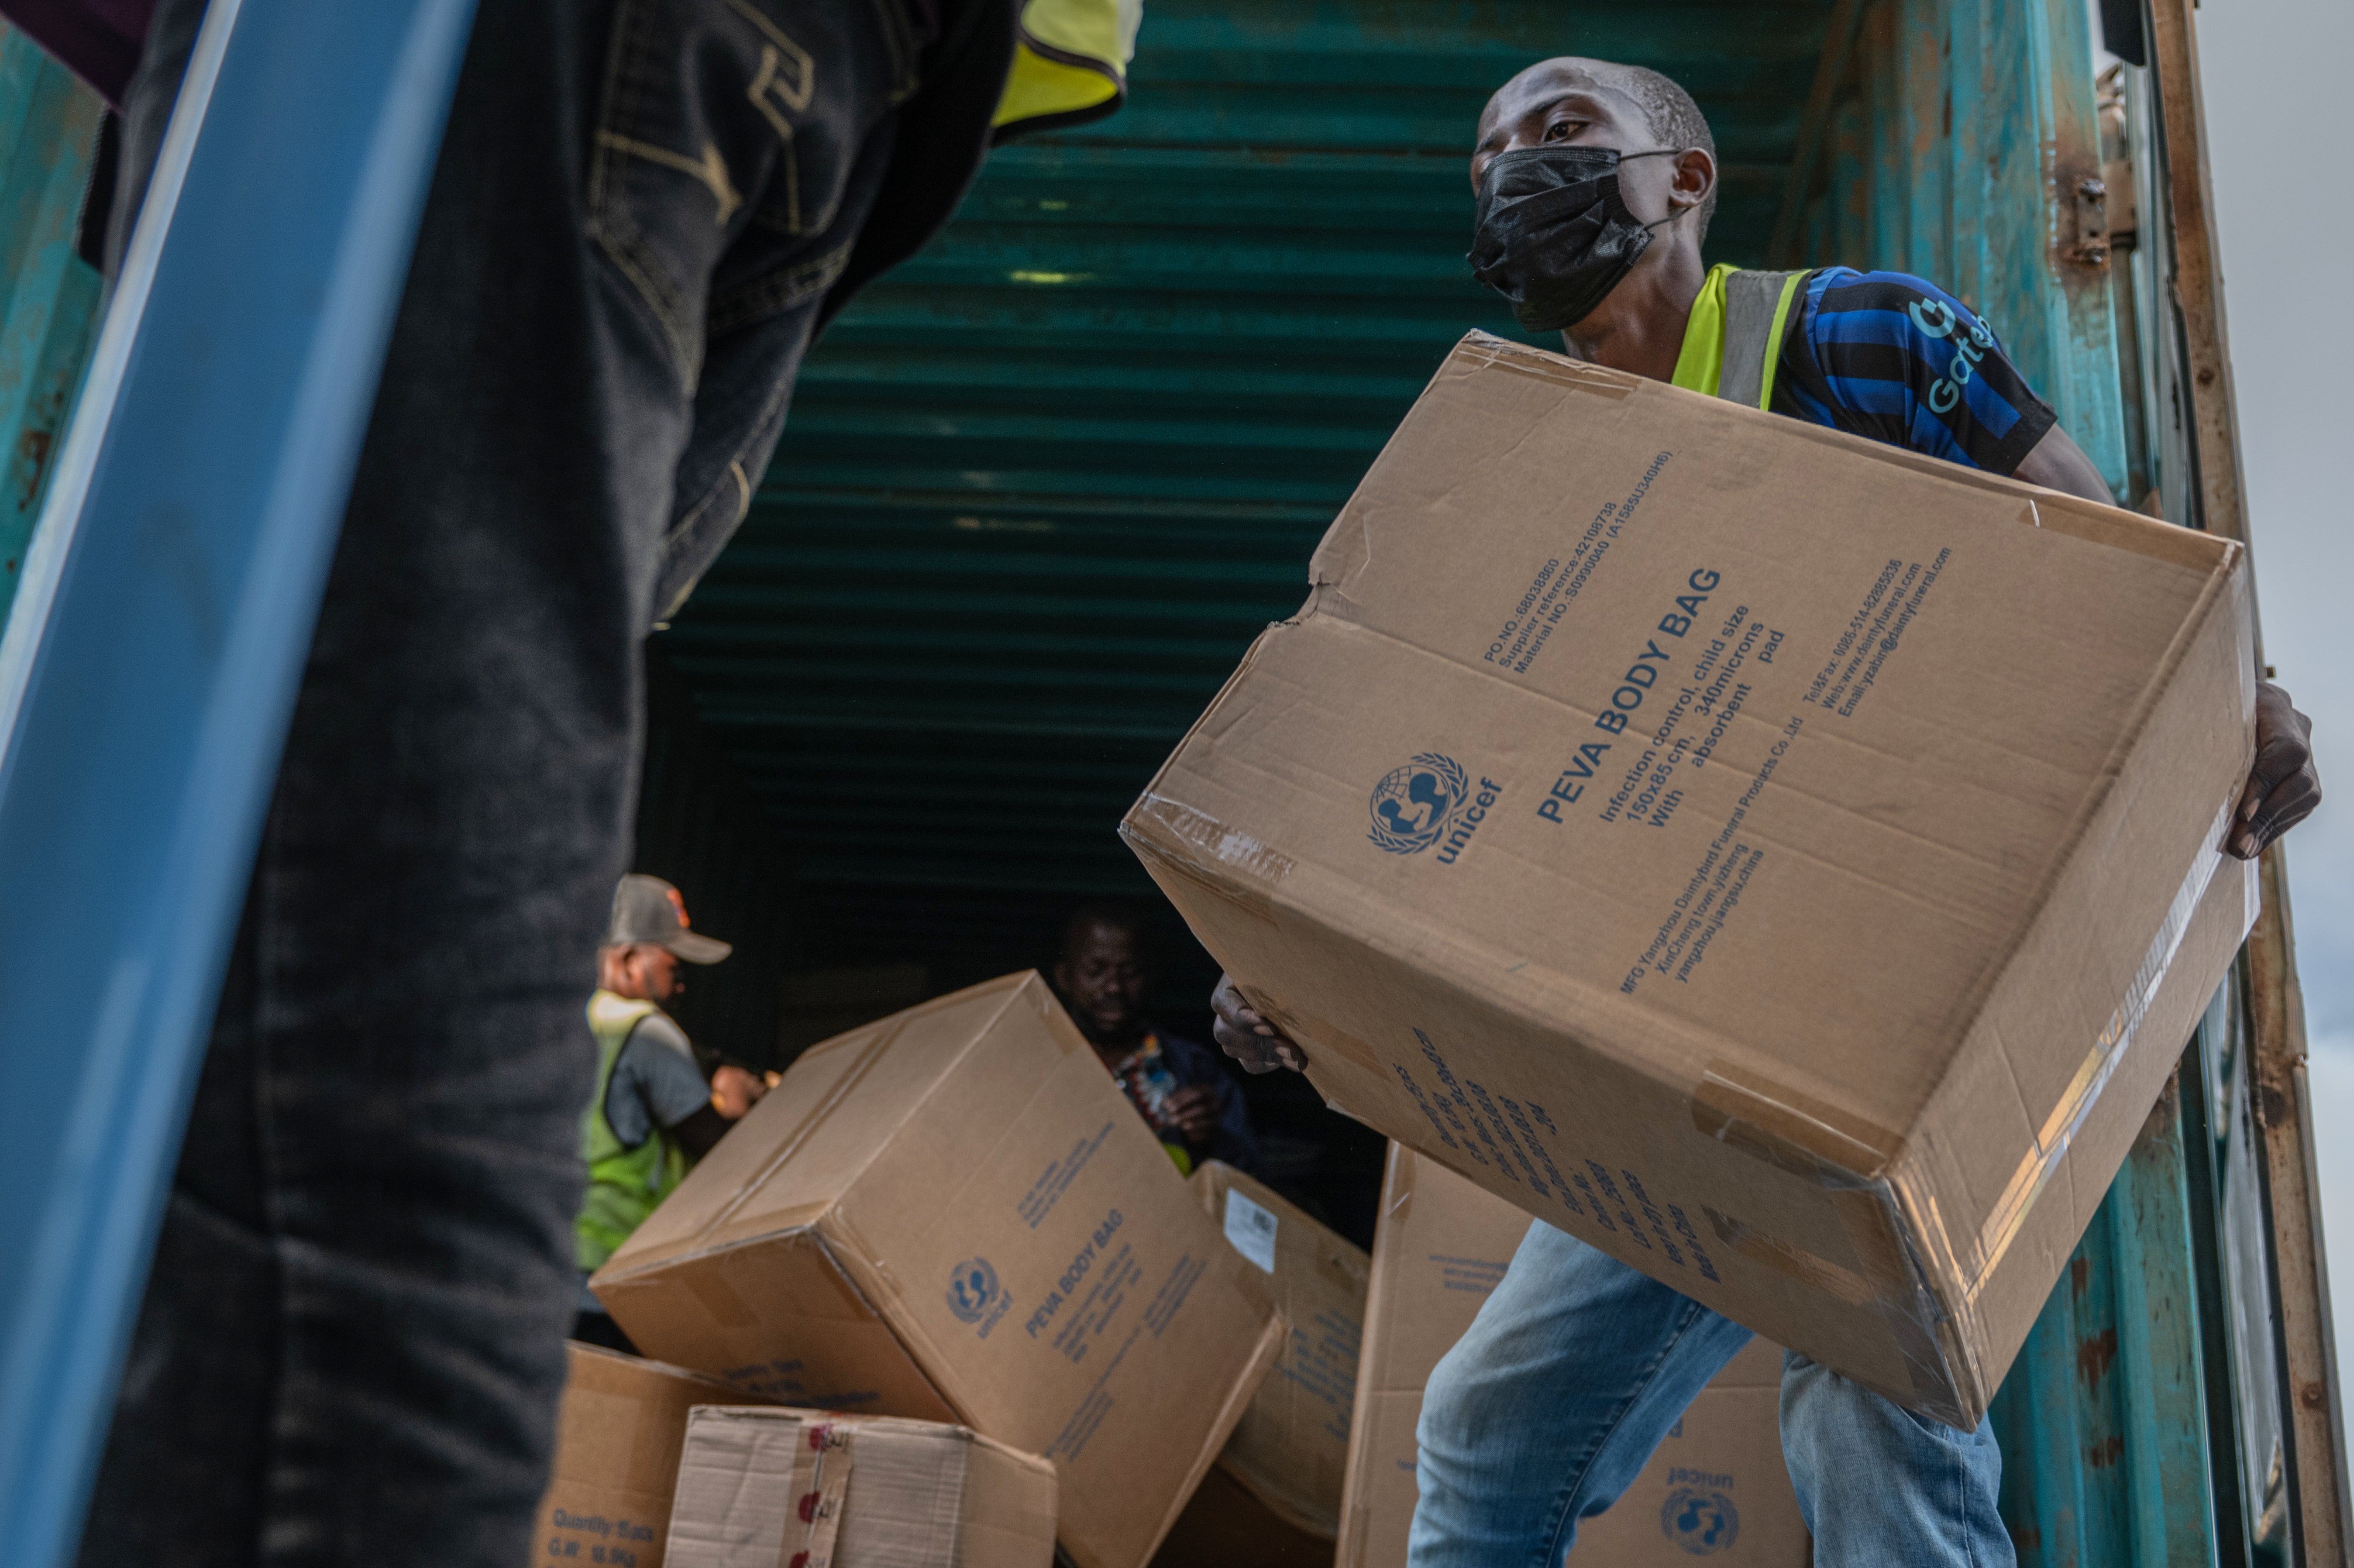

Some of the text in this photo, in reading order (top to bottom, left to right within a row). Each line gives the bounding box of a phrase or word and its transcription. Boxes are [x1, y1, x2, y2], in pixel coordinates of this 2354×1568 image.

[1483, 559, 1559, 662] PO.NO.:68038860
[1499, 502, 1617, 667] Supplier reference:42108738
[1514, 625, 1553, 673] Material
[1547, 541, 1609, 623] NO.:S0990040
[1537, 568, 1720, 823] PEVA BODY BAG
[1599, 605, 1748, 822] Infection control, child size
[1648, 629, 1784, 827] With absorbent pad
[1694, 622, 1764, 716] 340microns
[1437, 777, 1501, 864] unicef
[1674, 849, 1719, 909] Daintybird
[1710, 807, 1745, 851] Funeral
[1738, 758, 1778, 807] Products
[1655, 918, 1702, 974] XinCheng
[1025, 1291, 1064, 1339] PEVA
[1058, 1242, 1096, 1295] BODY
[1092, 1208, 1123, 1248] BAG
